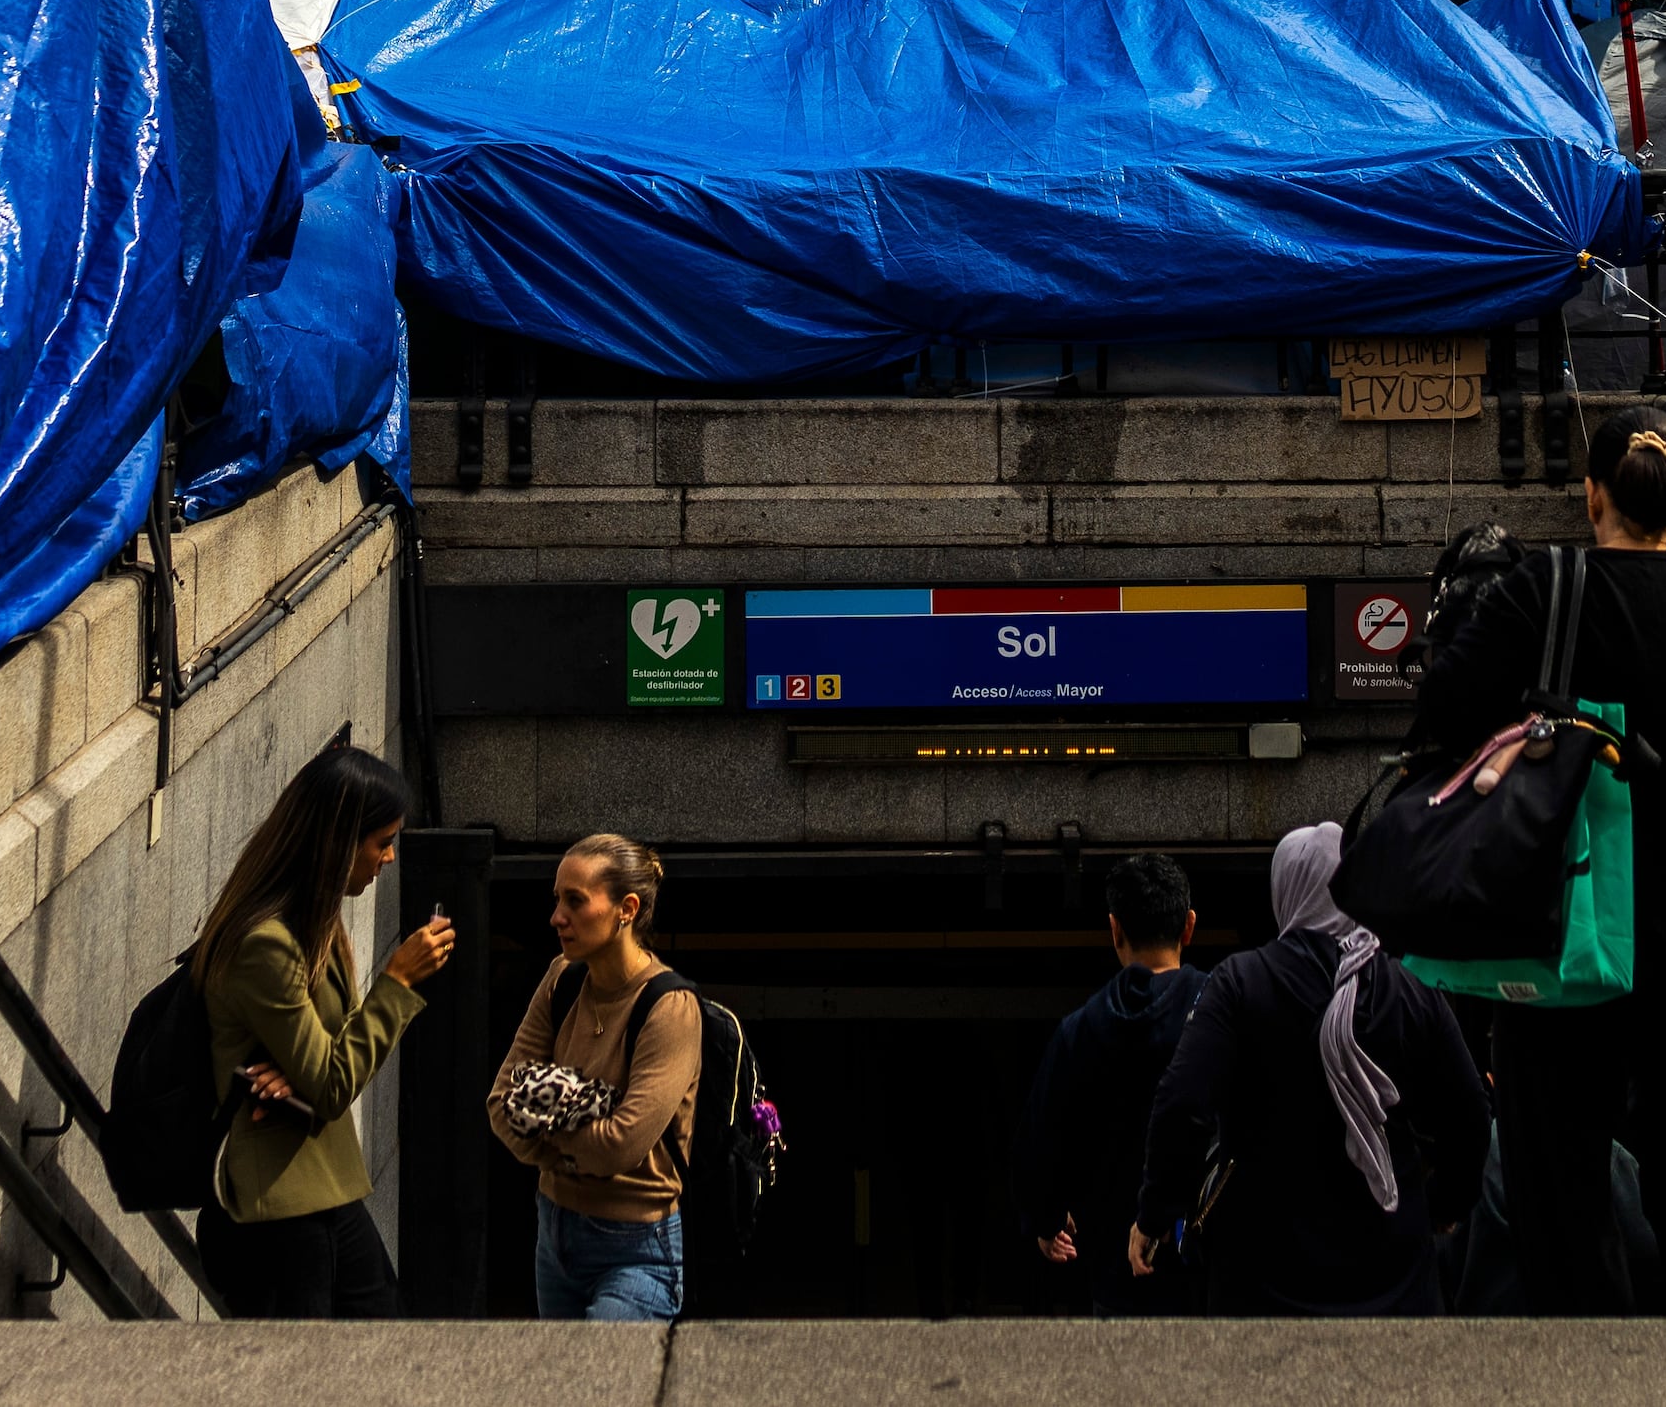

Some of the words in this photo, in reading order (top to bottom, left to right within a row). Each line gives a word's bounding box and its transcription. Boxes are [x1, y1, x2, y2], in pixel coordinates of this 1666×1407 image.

[1348, 376, 1474, 415] AYUSO
[997, 625, 1056, 658] Sol
[632, 668, 671, 679] Estación
[673, 668, 705, 679] dotada
[707, 668, 719, 679] de
[1339, 662, 1393, 673] Prohibido
[646, 680, 704, 691] desfibrilador
[765, 678, 774, 697] 1
[792, 678, 806, 697] 2
[822, 678, 835, 697] 3
[1352, 677, 1368, 687] No
[1370, 677, 1413, 689] smoking
[1056, 683, 1103, 700] Mayor
